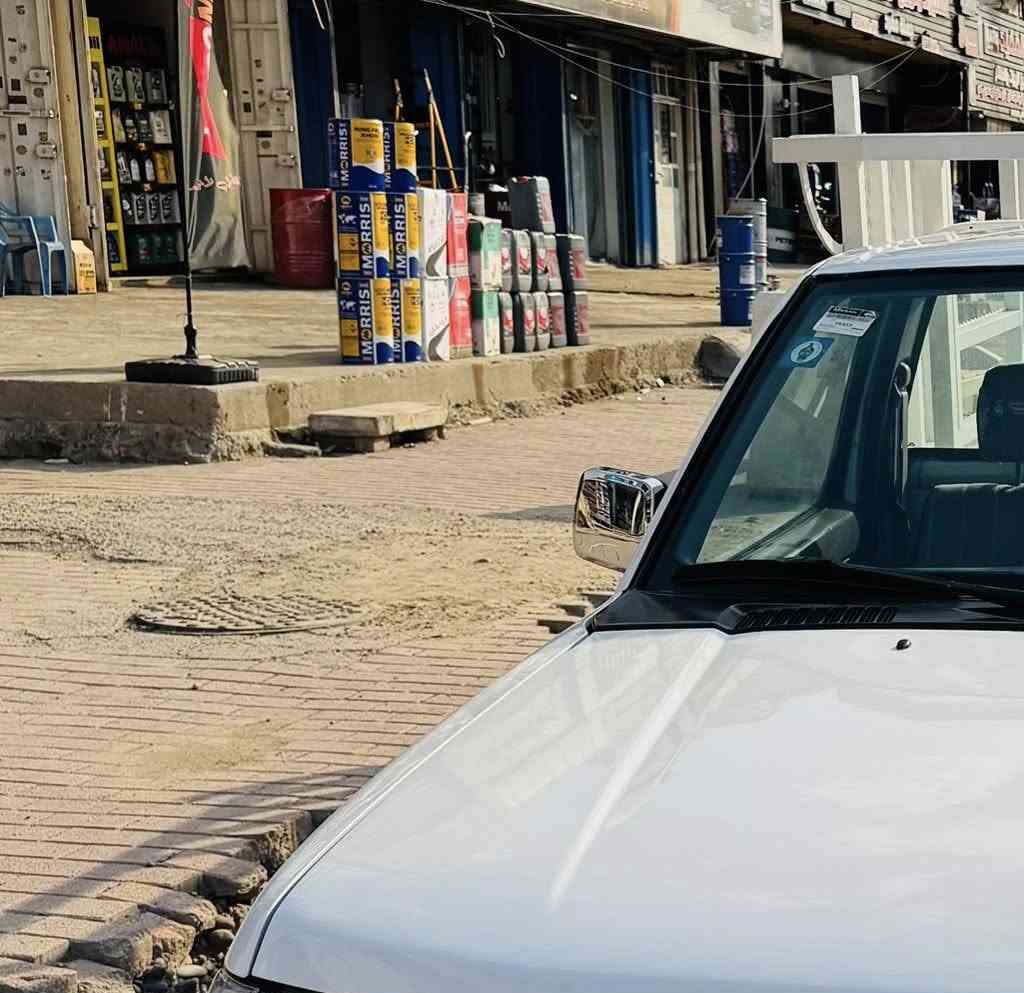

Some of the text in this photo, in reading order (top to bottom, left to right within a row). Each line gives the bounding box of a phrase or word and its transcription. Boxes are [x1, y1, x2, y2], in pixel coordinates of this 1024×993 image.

[339, 127, 349, 183] MORRIS
[360, 203, 373, 270] MORRIS
[394, 203, 407, 269] MORRIS
[358, 289, 373, 355] MORRIS
